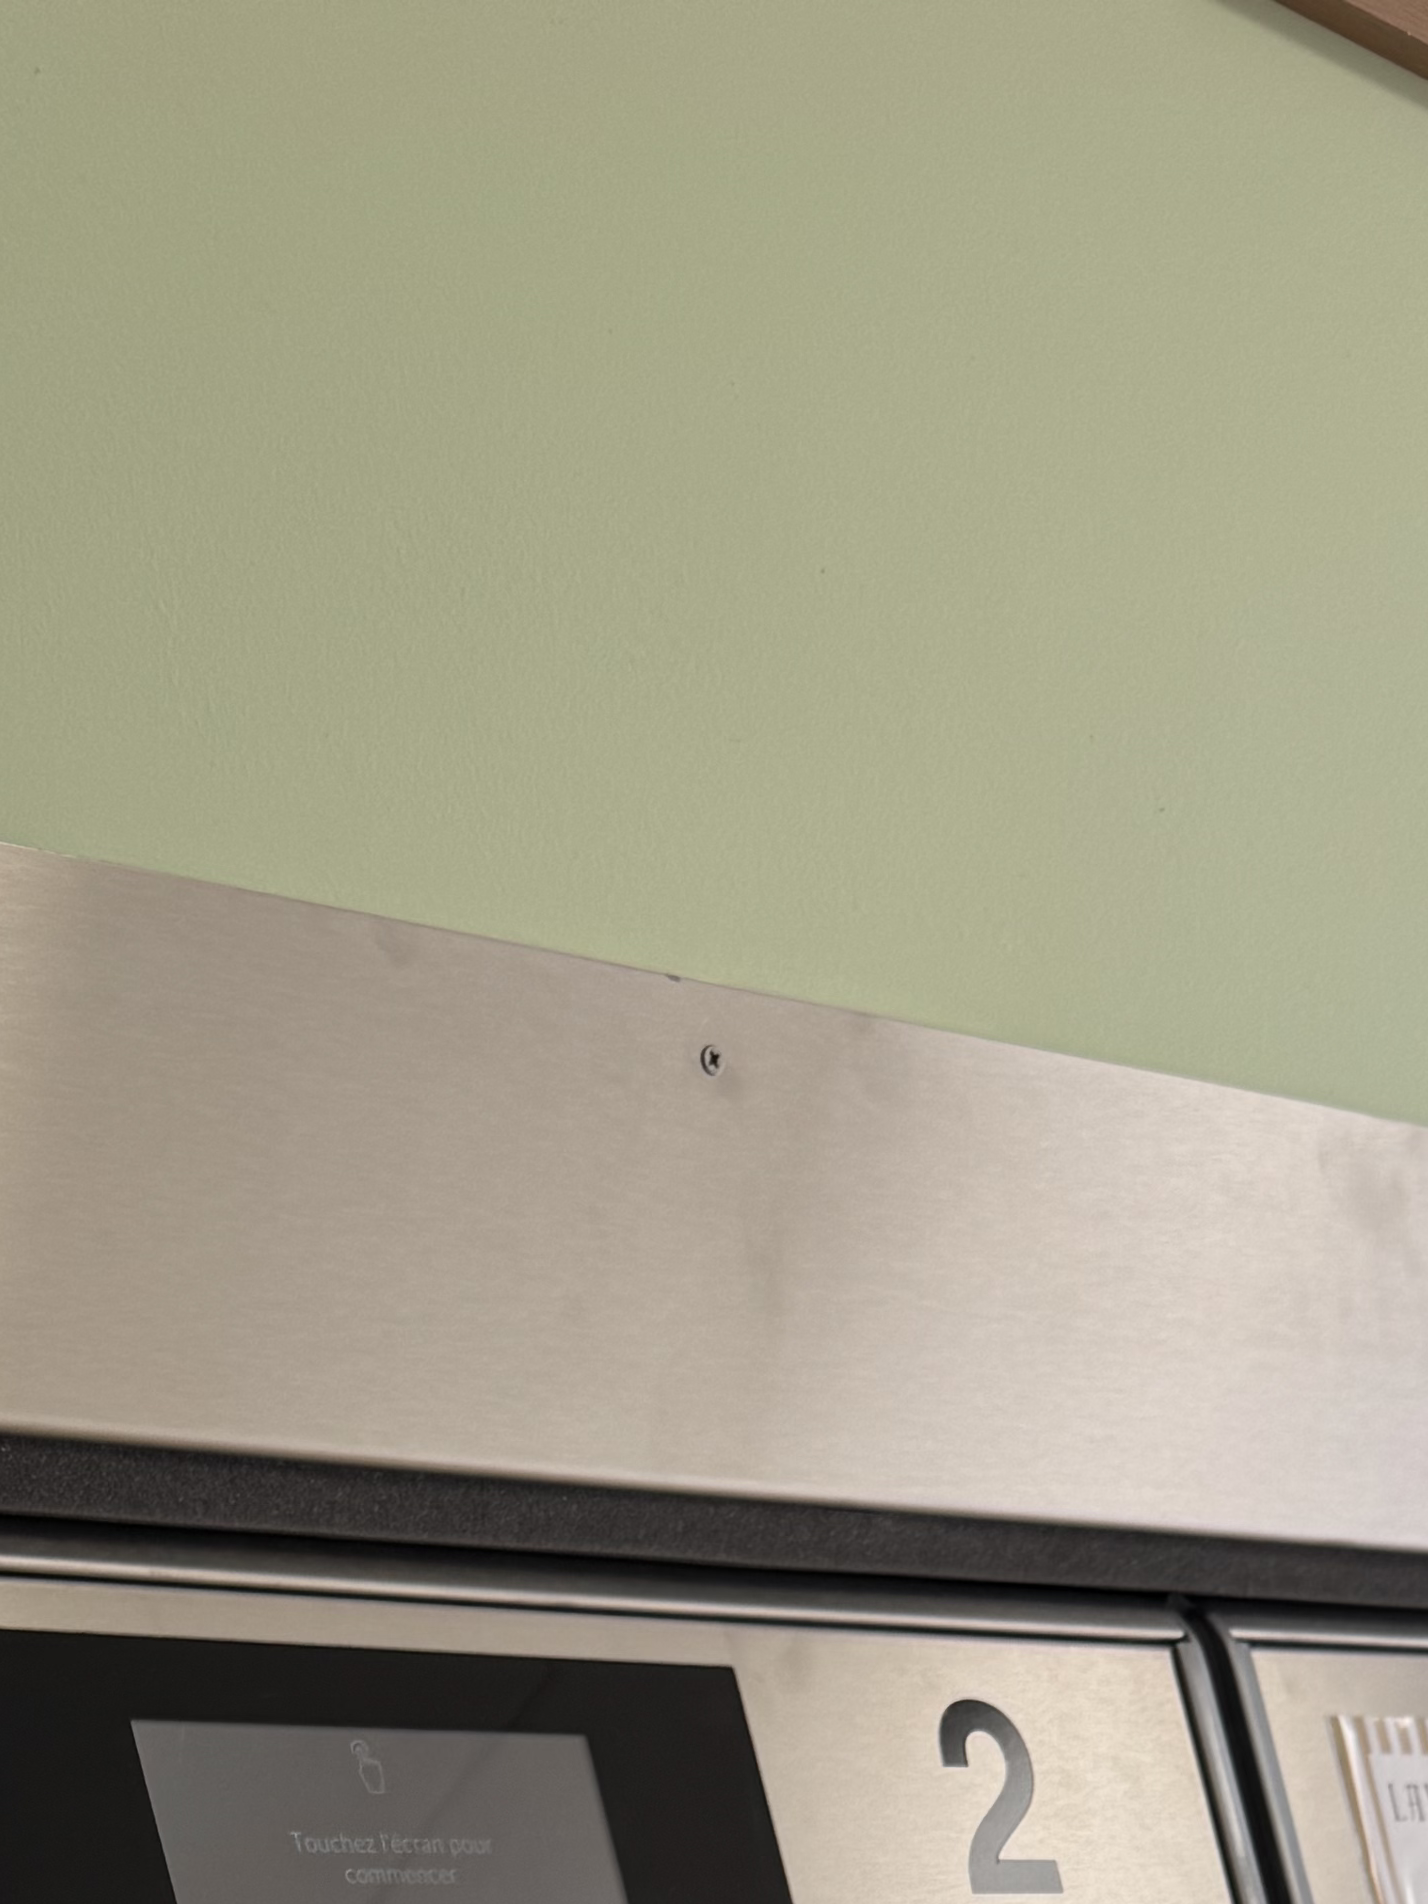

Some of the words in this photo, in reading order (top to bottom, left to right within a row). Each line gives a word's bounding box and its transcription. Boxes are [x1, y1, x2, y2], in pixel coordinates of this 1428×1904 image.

[289, 1831, 377, 1853] Touchez
[379, 1831, 444, 1854] l'écran
[449, 1838, 492, 1858] pour
[938, 1698, 1063, 1894] 2
